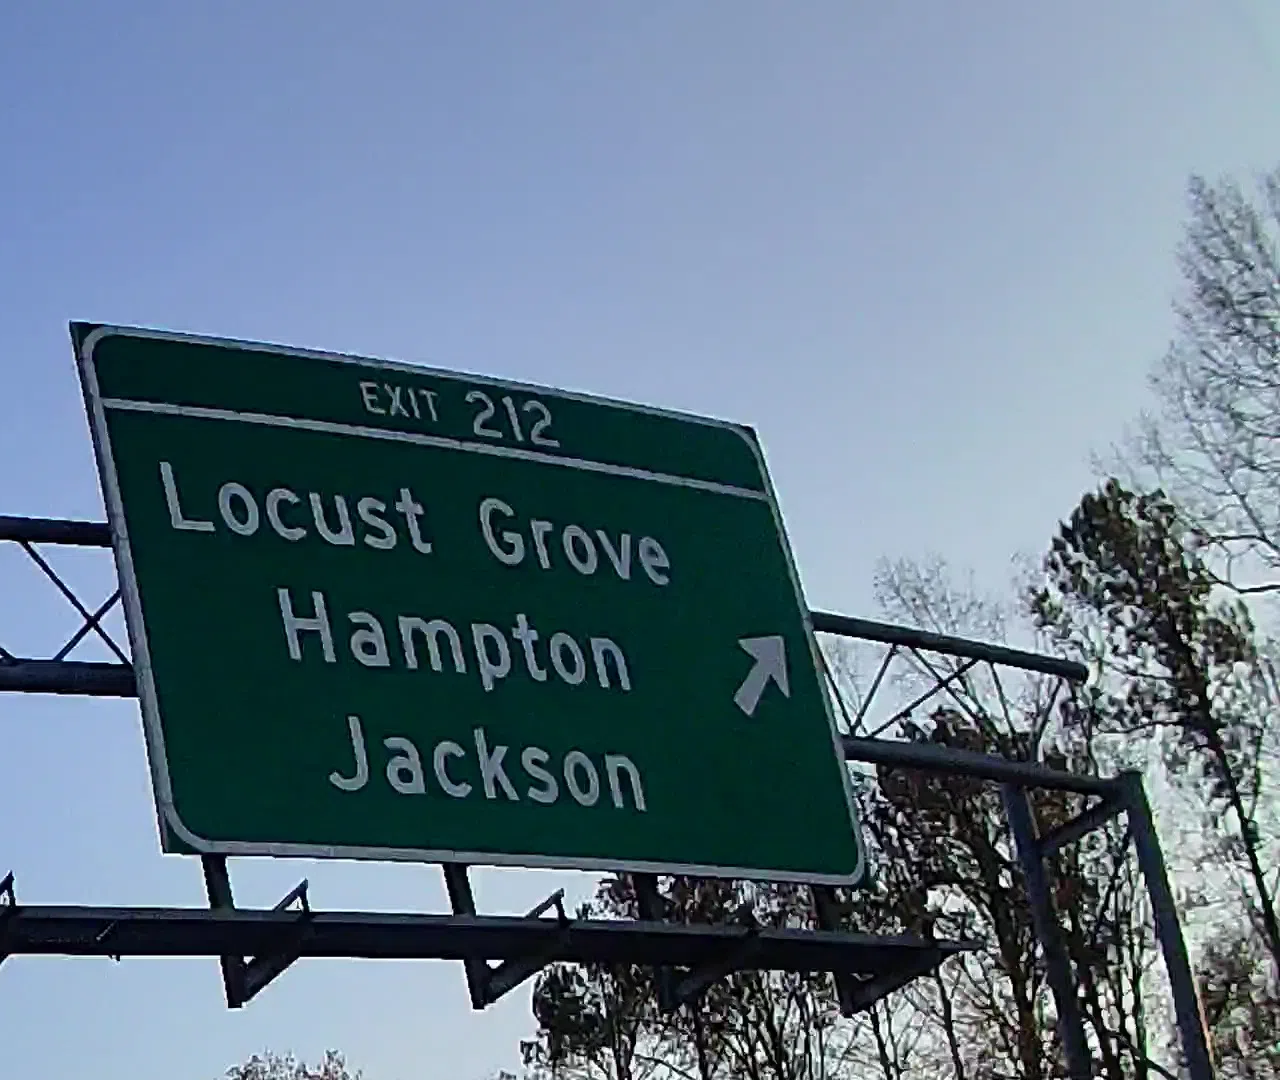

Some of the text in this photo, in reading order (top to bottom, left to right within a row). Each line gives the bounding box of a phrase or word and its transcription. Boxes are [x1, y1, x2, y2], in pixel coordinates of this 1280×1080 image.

[359, 381, 560, 449] EXIT 212
[159, 461, 671, 586] Locust Grove
[278, 588, 632, 692] Hampton
[329, 716, 647, 812] Jackson
